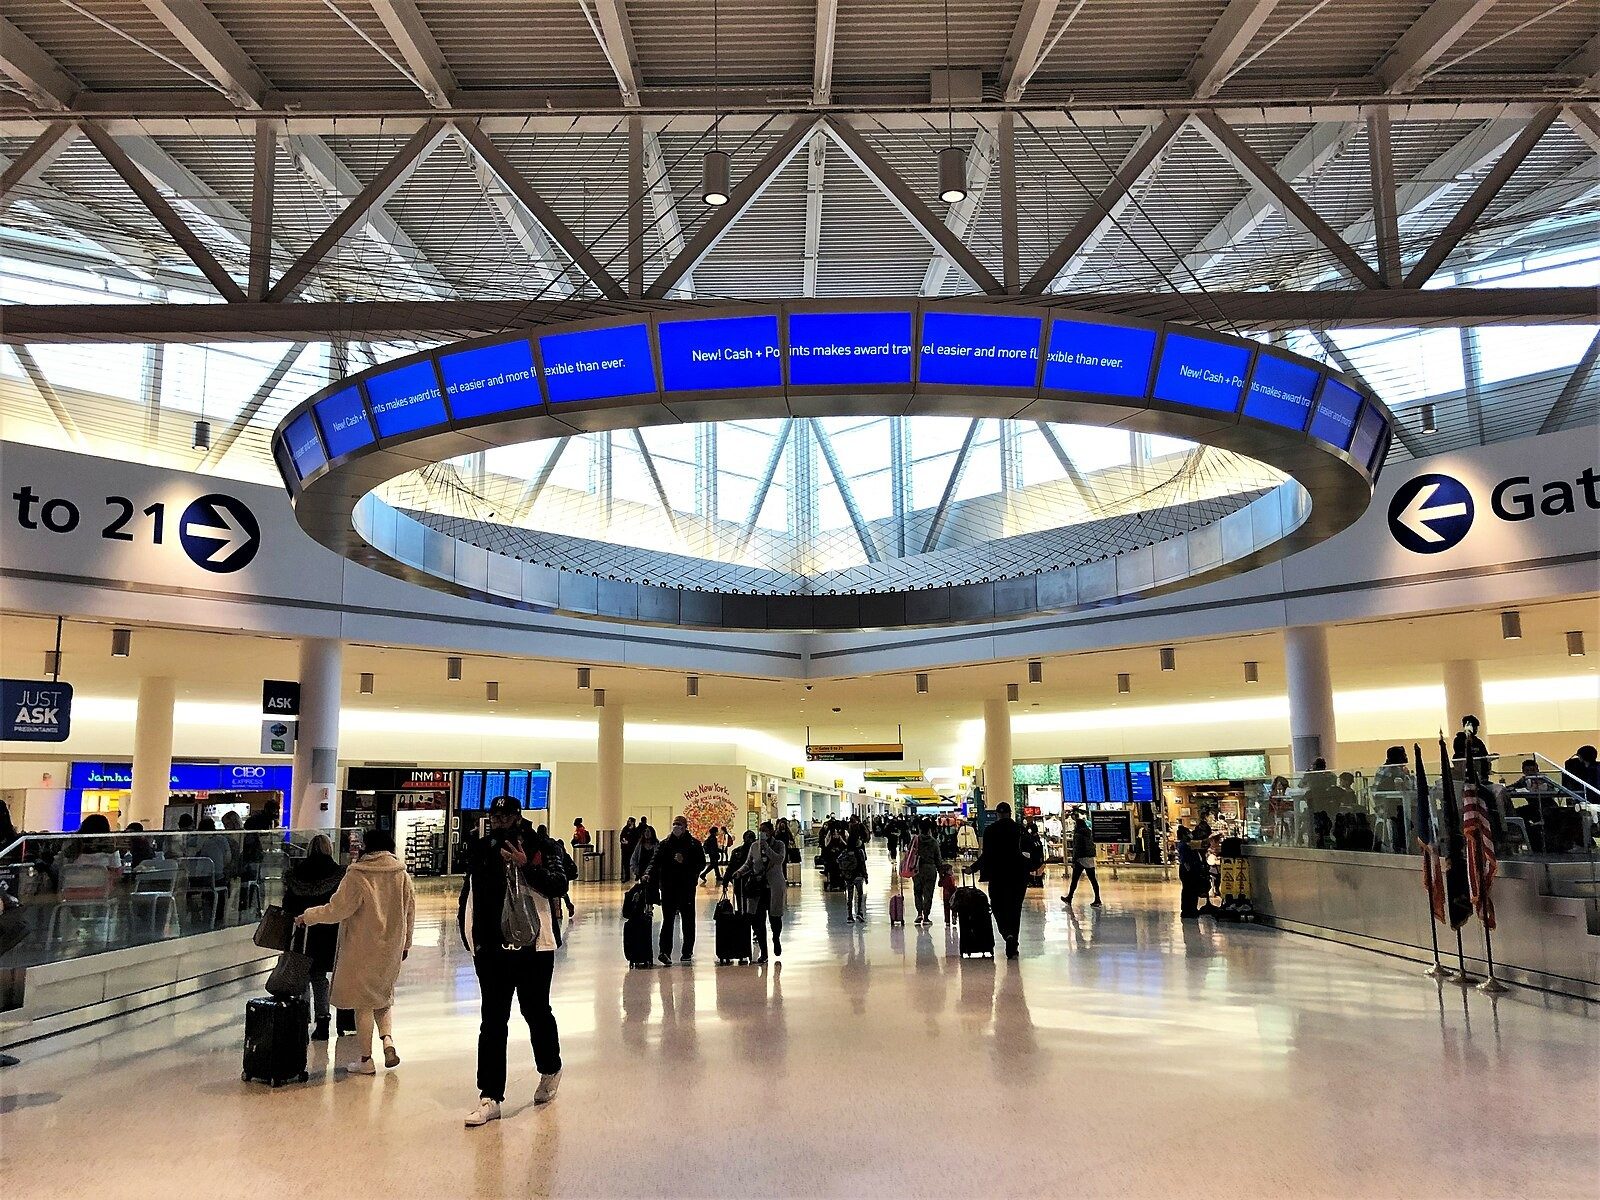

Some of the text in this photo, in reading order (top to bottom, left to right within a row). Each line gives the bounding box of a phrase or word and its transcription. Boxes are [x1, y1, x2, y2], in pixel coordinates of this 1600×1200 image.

[692, 349, 722, 361] New!
[724, 348, 753, 360] Cash
[813, 344, 851, 356] makes
[854, 343, 890, 355] award
[937, 344, 972, 356] easier
[974, 346, 995, 357] and
[998, 349, 1027, 359] more
[1076, 354, 1098, 366] than
[1100, 358, 1123, 368] ever.
[346, 414, 359, 426] Cash
[386, 397, 409, 410] makes
[409, 389, 431, 404] award
[460, 379, 485, 392] easier
[487, 373, 504, 387] and
[506, 370, 530, 382] more
[576, 361, 599, 372] than
[601, 359, 626, 370] ever.
[1180, 365, 1203, 379] New!
[1203, 370, 1223, 384] Cash
[1260, 384, 1282, 398] makes
[1282, 391, 1302, 405] award
[13, 486, 165, 545] to 21
[16, 690, 61, 707] JUST
[267, 697, 292, 709] ASK
[15, 706, 59, 724] ASK
[88, 770, 132, 782] jamba
[232, 767, 265, 778] CIBO
[684, 790, 700, 801] Hey
[698, 784, 713, 794] New
